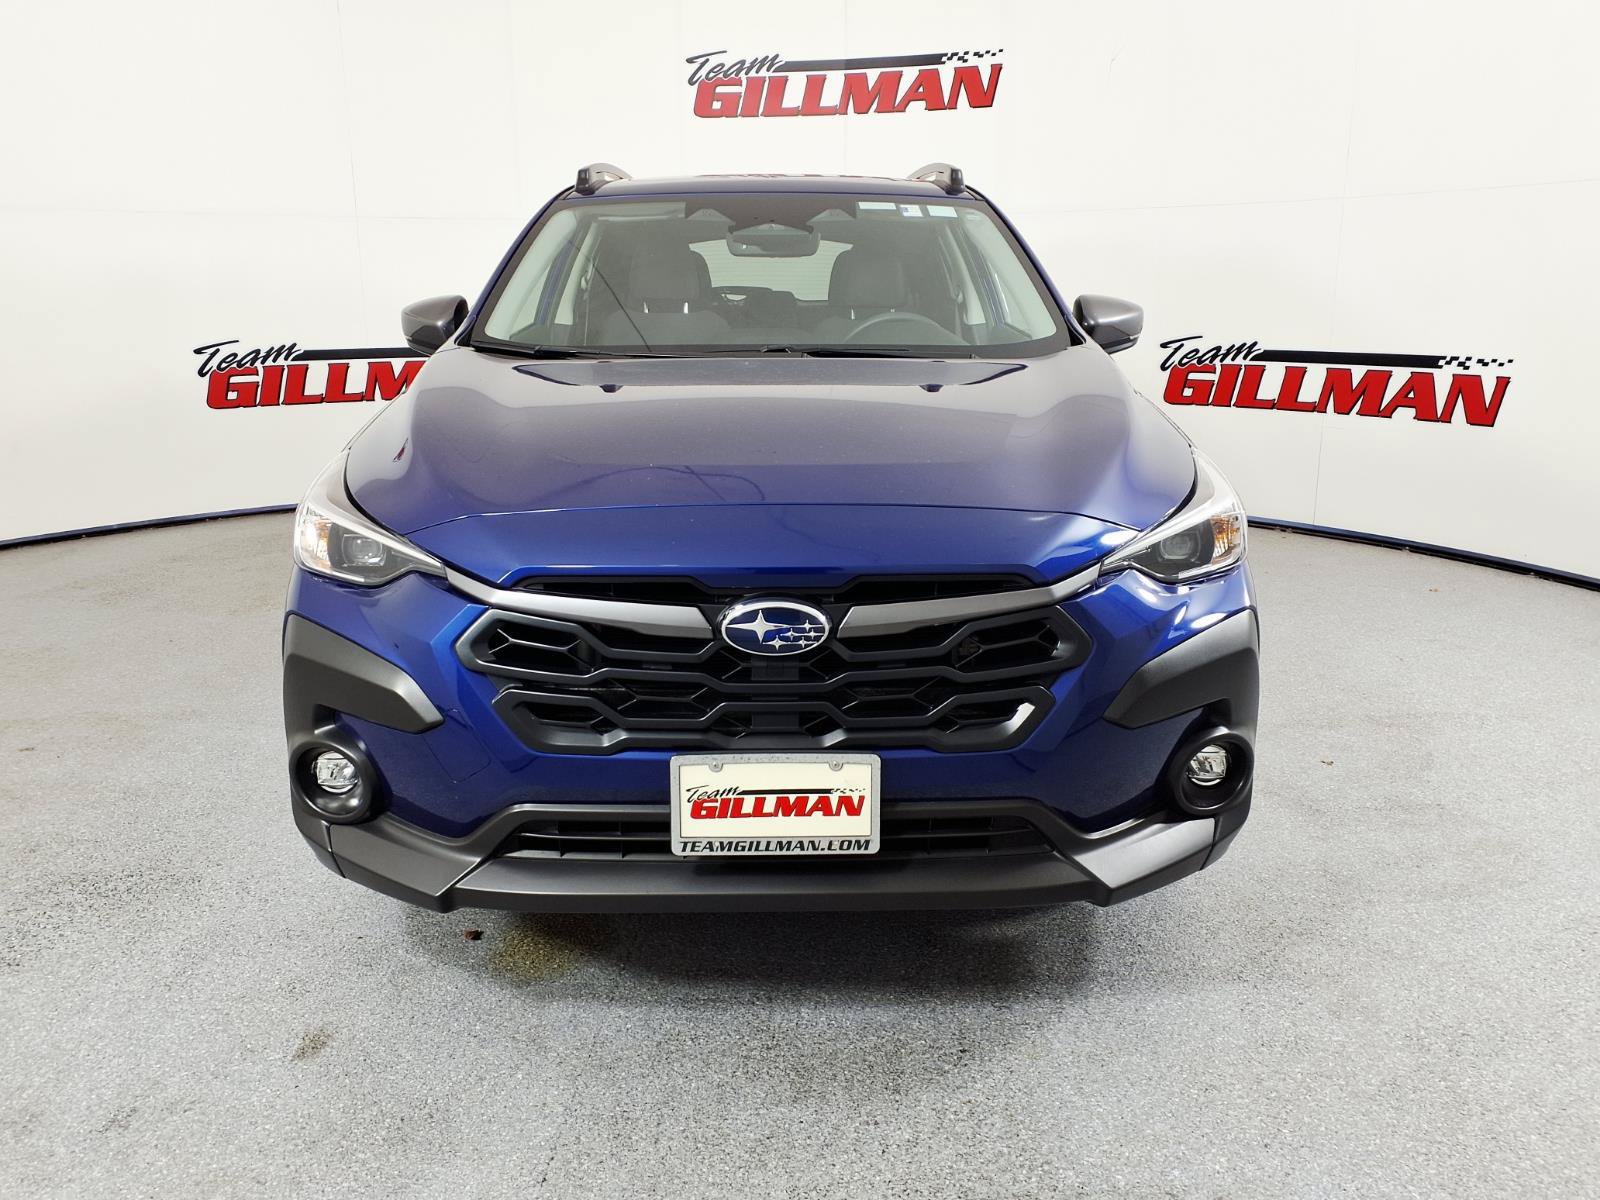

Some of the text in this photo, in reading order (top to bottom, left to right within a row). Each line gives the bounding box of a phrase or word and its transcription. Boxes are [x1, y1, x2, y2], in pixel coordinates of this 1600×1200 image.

[685, 50, 785, 86] Team
[694, 64, 1003, 118] GILLMAN
[193, 340, 302, 377] Team
[1160, 335, 1262, 371] Team
[206, 360, 427, 409] GILLM
[1163, 364, 1511, 427] GILLMAN
[685, 785, 742, 803] Team
[690, 795, 865, 819] GILLMAN
[680, 840, 870, 853] TEAMGILLMAN.COM
